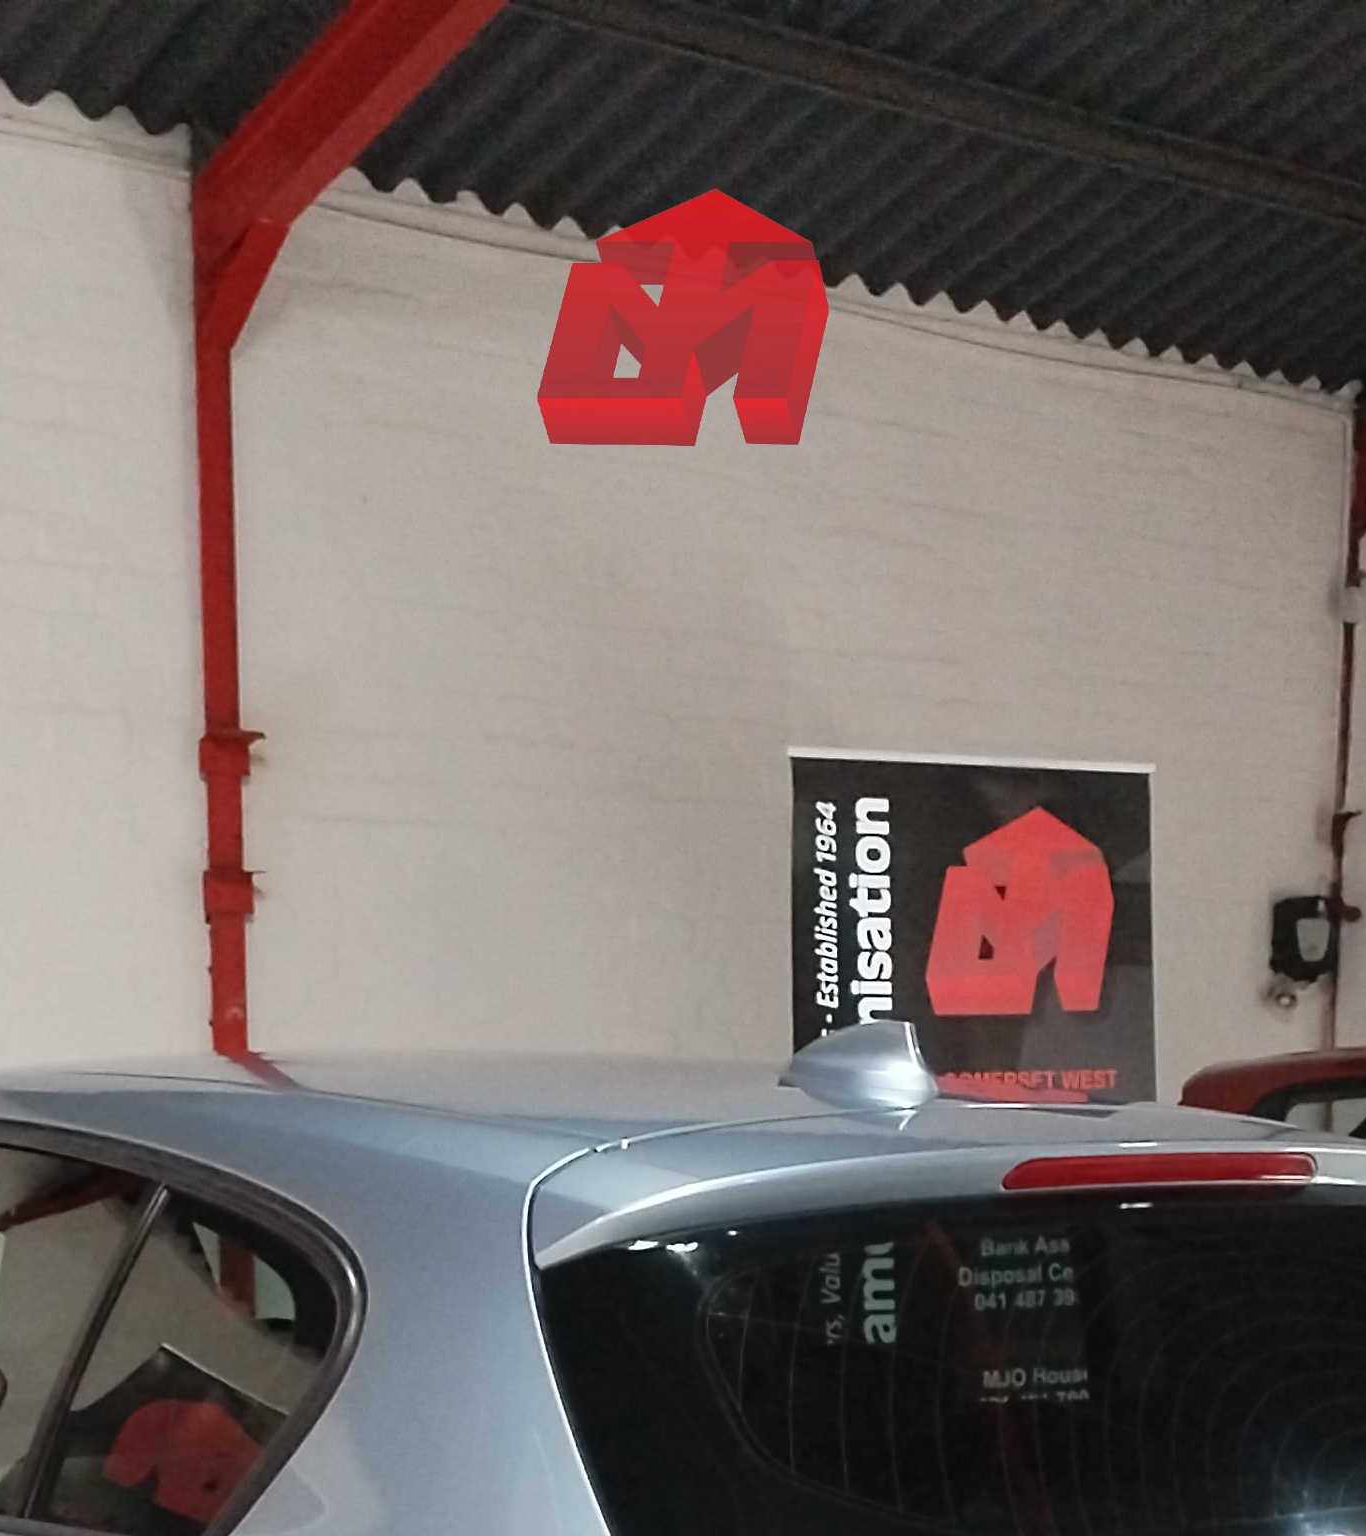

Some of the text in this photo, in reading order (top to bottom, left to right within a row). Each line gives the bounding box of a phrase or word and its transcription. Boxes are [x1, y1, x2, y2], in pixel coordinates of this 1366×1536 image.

[814, 801, 838, 862] 1964
[813, 867, 839, 1009] Established
[974, 1290, 1007, 1311] 041
